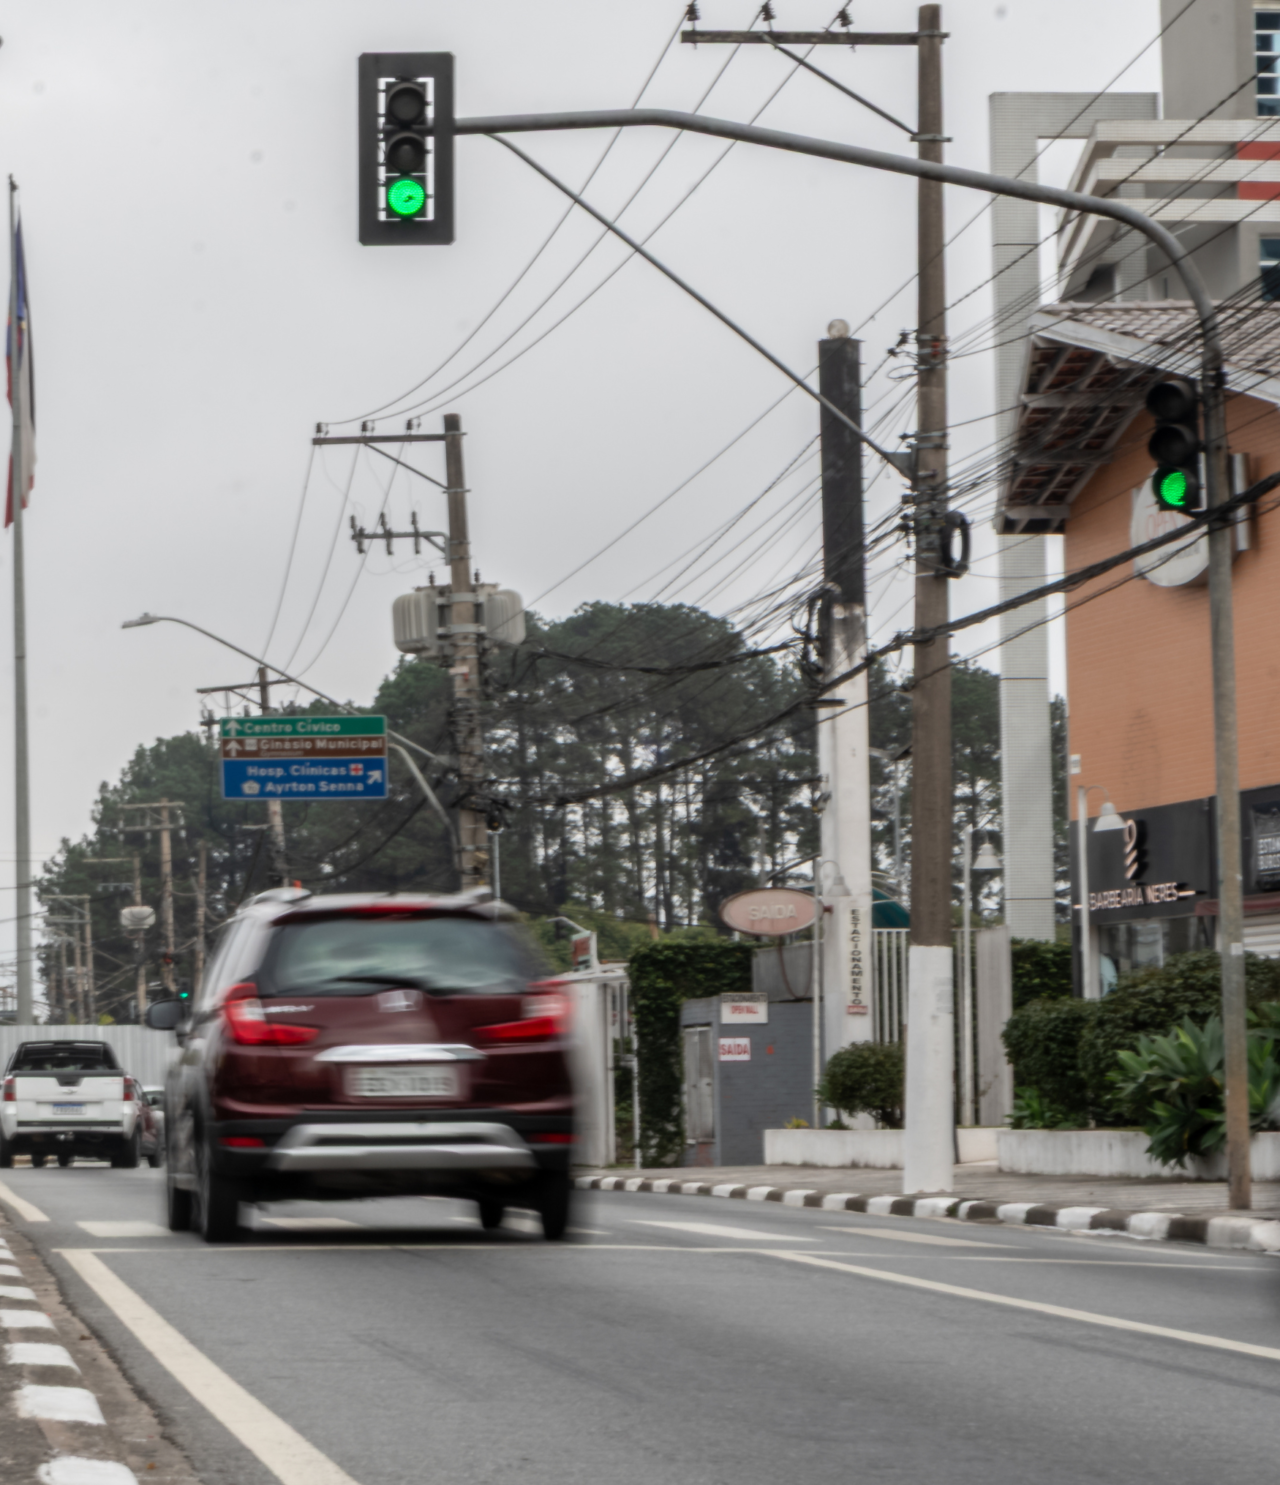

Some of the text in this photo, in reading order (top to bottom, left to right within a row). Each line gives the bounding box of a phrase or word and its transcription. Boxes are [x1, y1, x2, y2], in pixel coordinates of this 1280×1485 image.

[244, 718, 341, 733] Centro Cívico
[260, 737, 382, 750] Ginásio Municipal
[247, 761, 347, 778] Hosp. Clínicas
[265, 781, 364, 794] Ayrton Senna
[1089, 887, 1144, 910] BARBEARIA
[749, 902, 797, 920] SAÍDA
[850, 908, 863, 1005] ESTACIONAMENTO
[720, 1040, 749, 1055] SAÍDA
